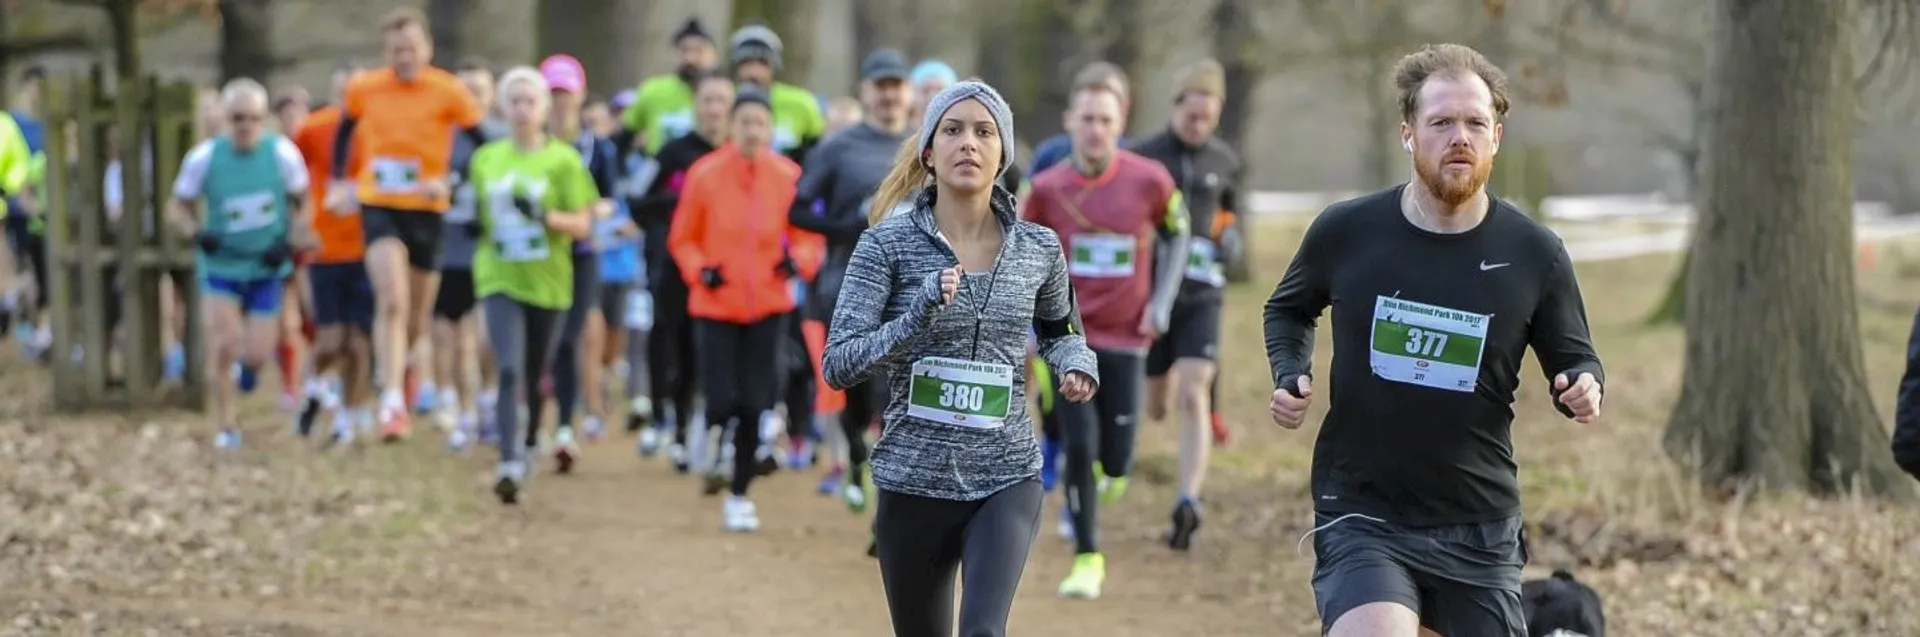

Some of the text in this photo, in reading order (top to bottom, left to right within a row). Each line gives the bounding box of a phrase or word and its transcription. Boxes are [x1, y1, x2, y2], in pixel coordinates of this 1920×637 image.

[1383, 299, 1481, 324] Run Richmond Park 10k 2017
[1405, 328, 1448, 357] 377
[933, 359, 968, 370] Richmond
[968, 364, 982, 372] Park
[939, 382, 984, 411] 380
